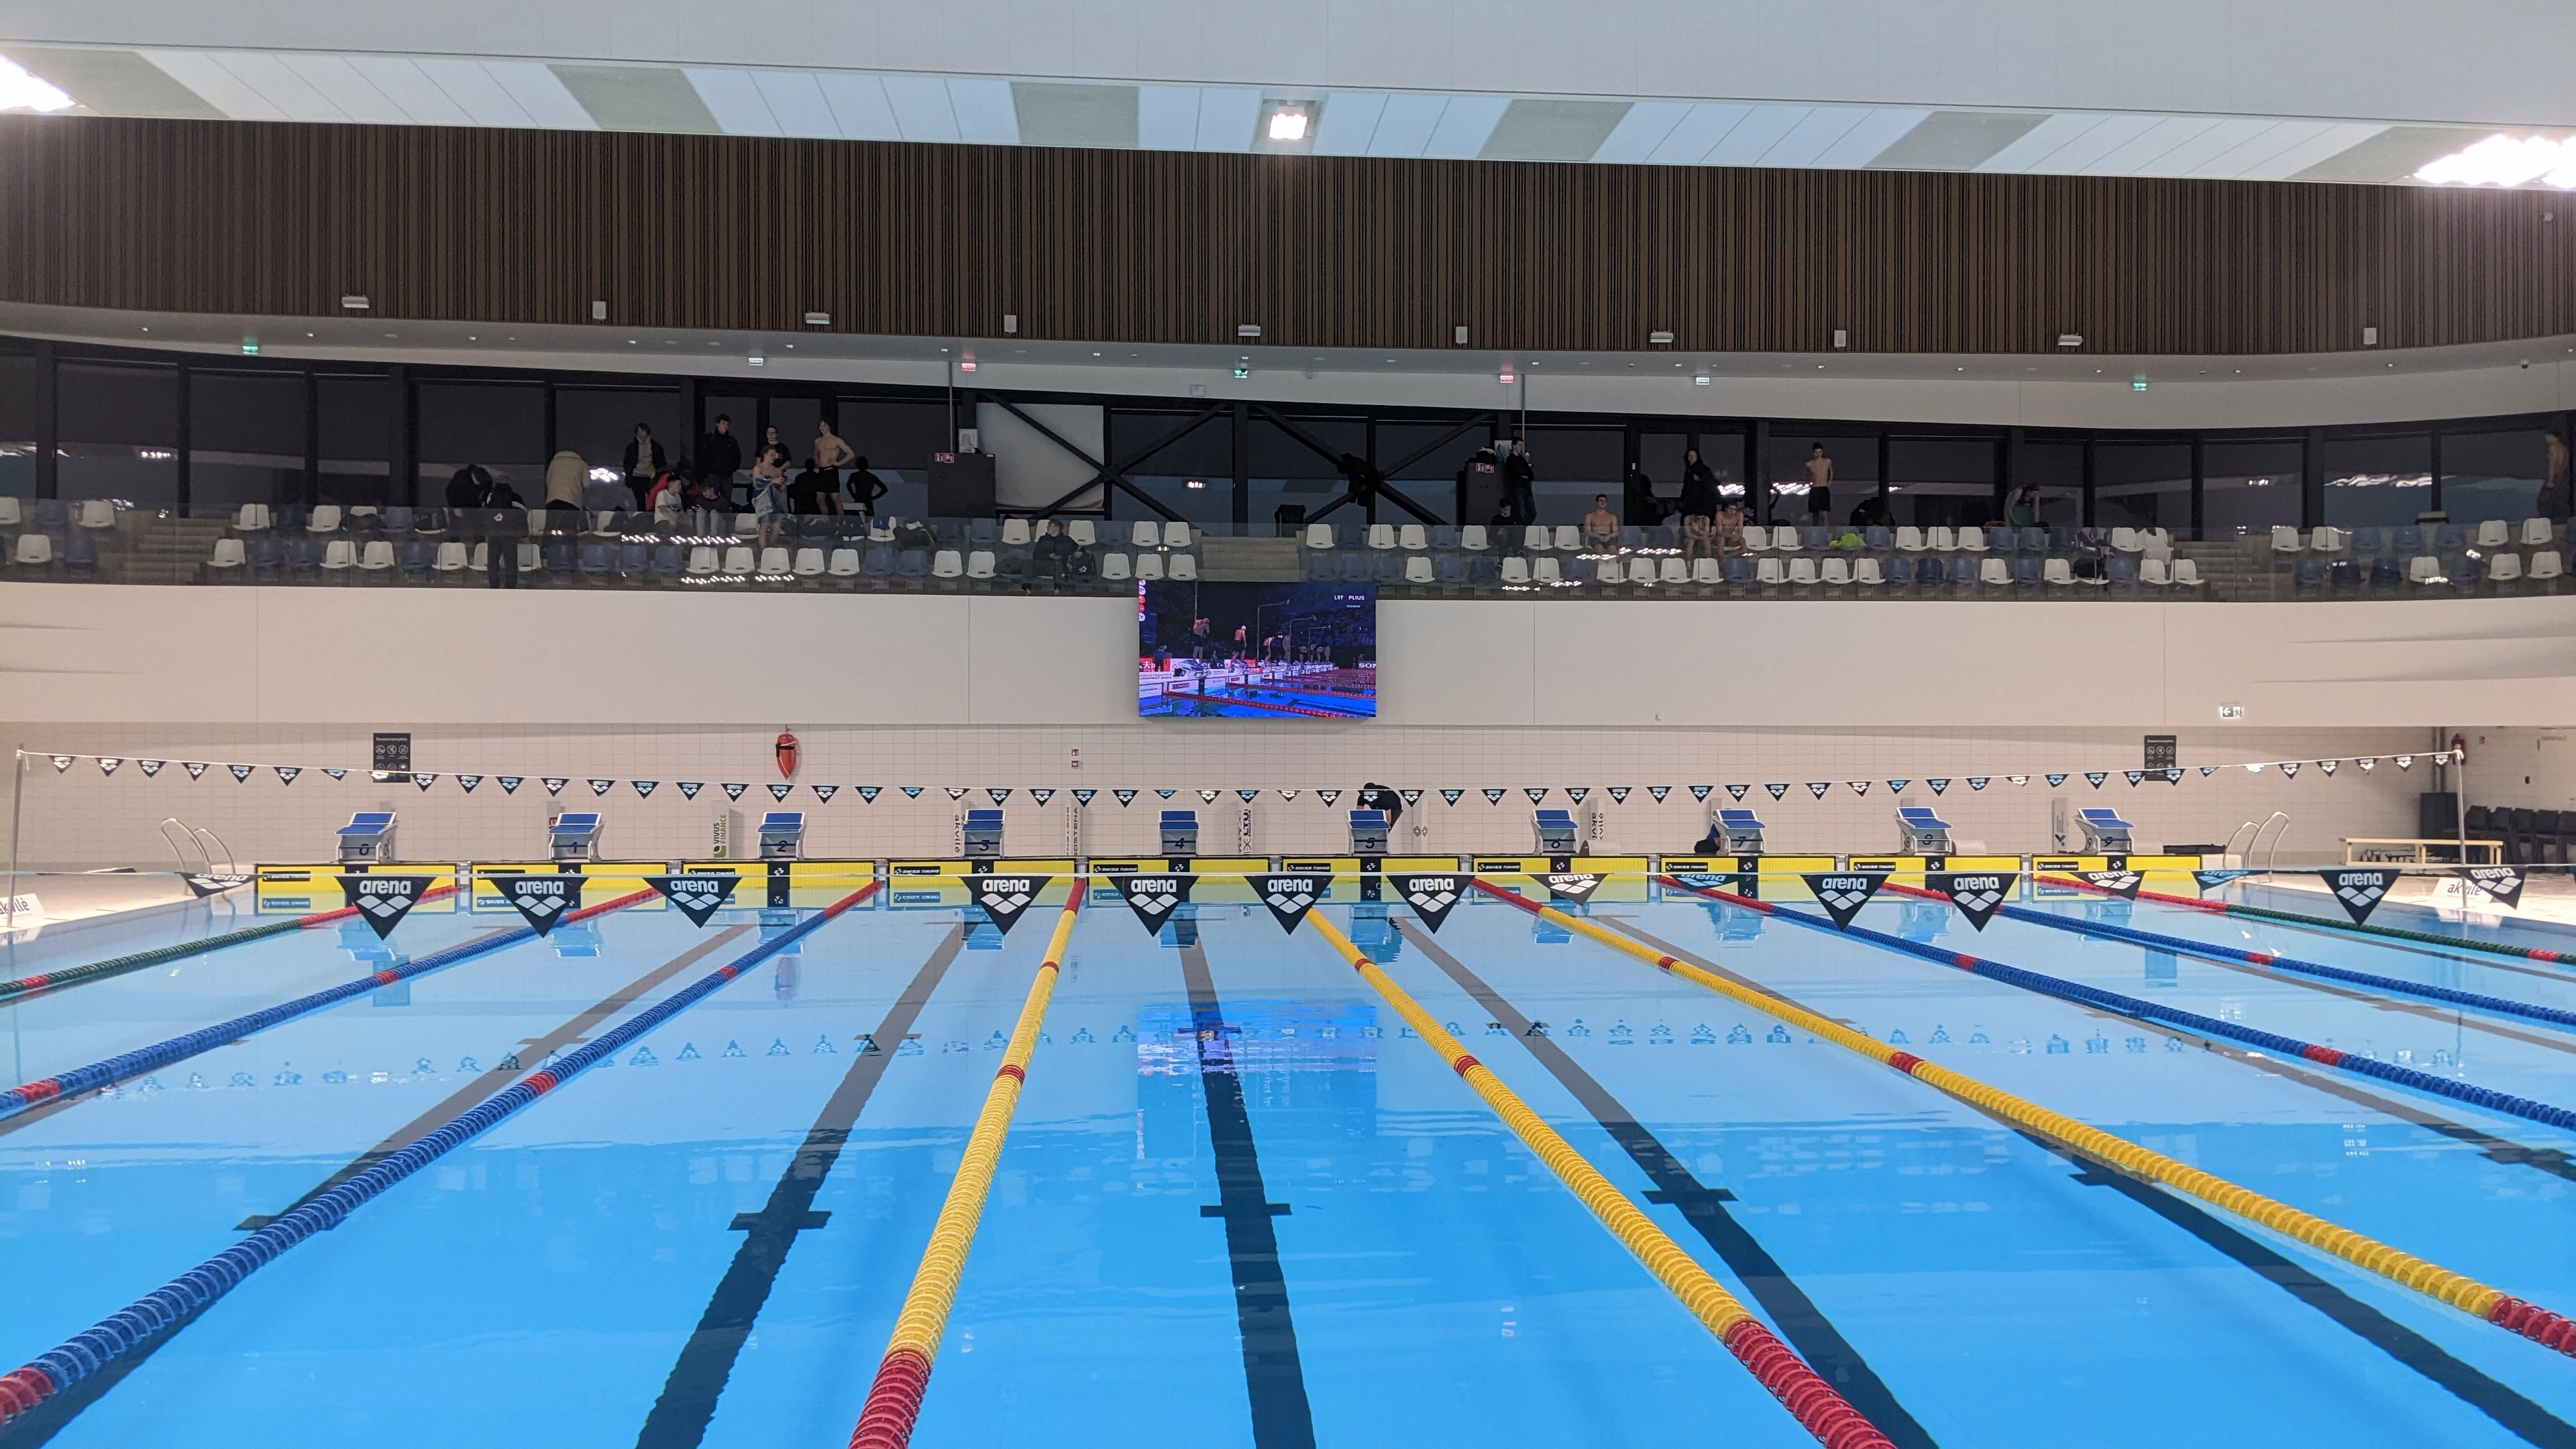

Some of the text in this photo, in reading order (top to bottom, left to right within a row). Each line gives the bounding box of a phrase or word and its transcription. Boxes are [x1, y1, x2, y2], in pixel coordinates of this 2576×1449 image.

[979, 840, 989, 851] 3
[1175, 837, 1185, 849] 4
[1365, 837, 1376, 849] 5
[1737, 836, 1747, 847] 7
[1923, 834, 1933, 845] 8
[2104, 837, 2113, 847] 9
[360, 843, 370, 855] 0
[571, 841, 577, 853] 1
[776, 840, 788, 852] 2
[1549, 873, 1595, 883] arena
[2088, 871, 2134, 881] arena
[2339, 872, 2383, 885] arena
[2471, 867, 2516, 879] arena
[360, 880, 411, 894] arena
[515, 881, 564, 894] arena
[670, 880, 718, 893] arena
[982, 879, 1030, 892] arena
[1131, 879, 1177, 892] arena
[1267, 879, 1313, 892] arena
[1409, 878, 1454, 892] arena
[1822, 877, 1867, 890] arena
[1954, 876, 2000, 890] arena
